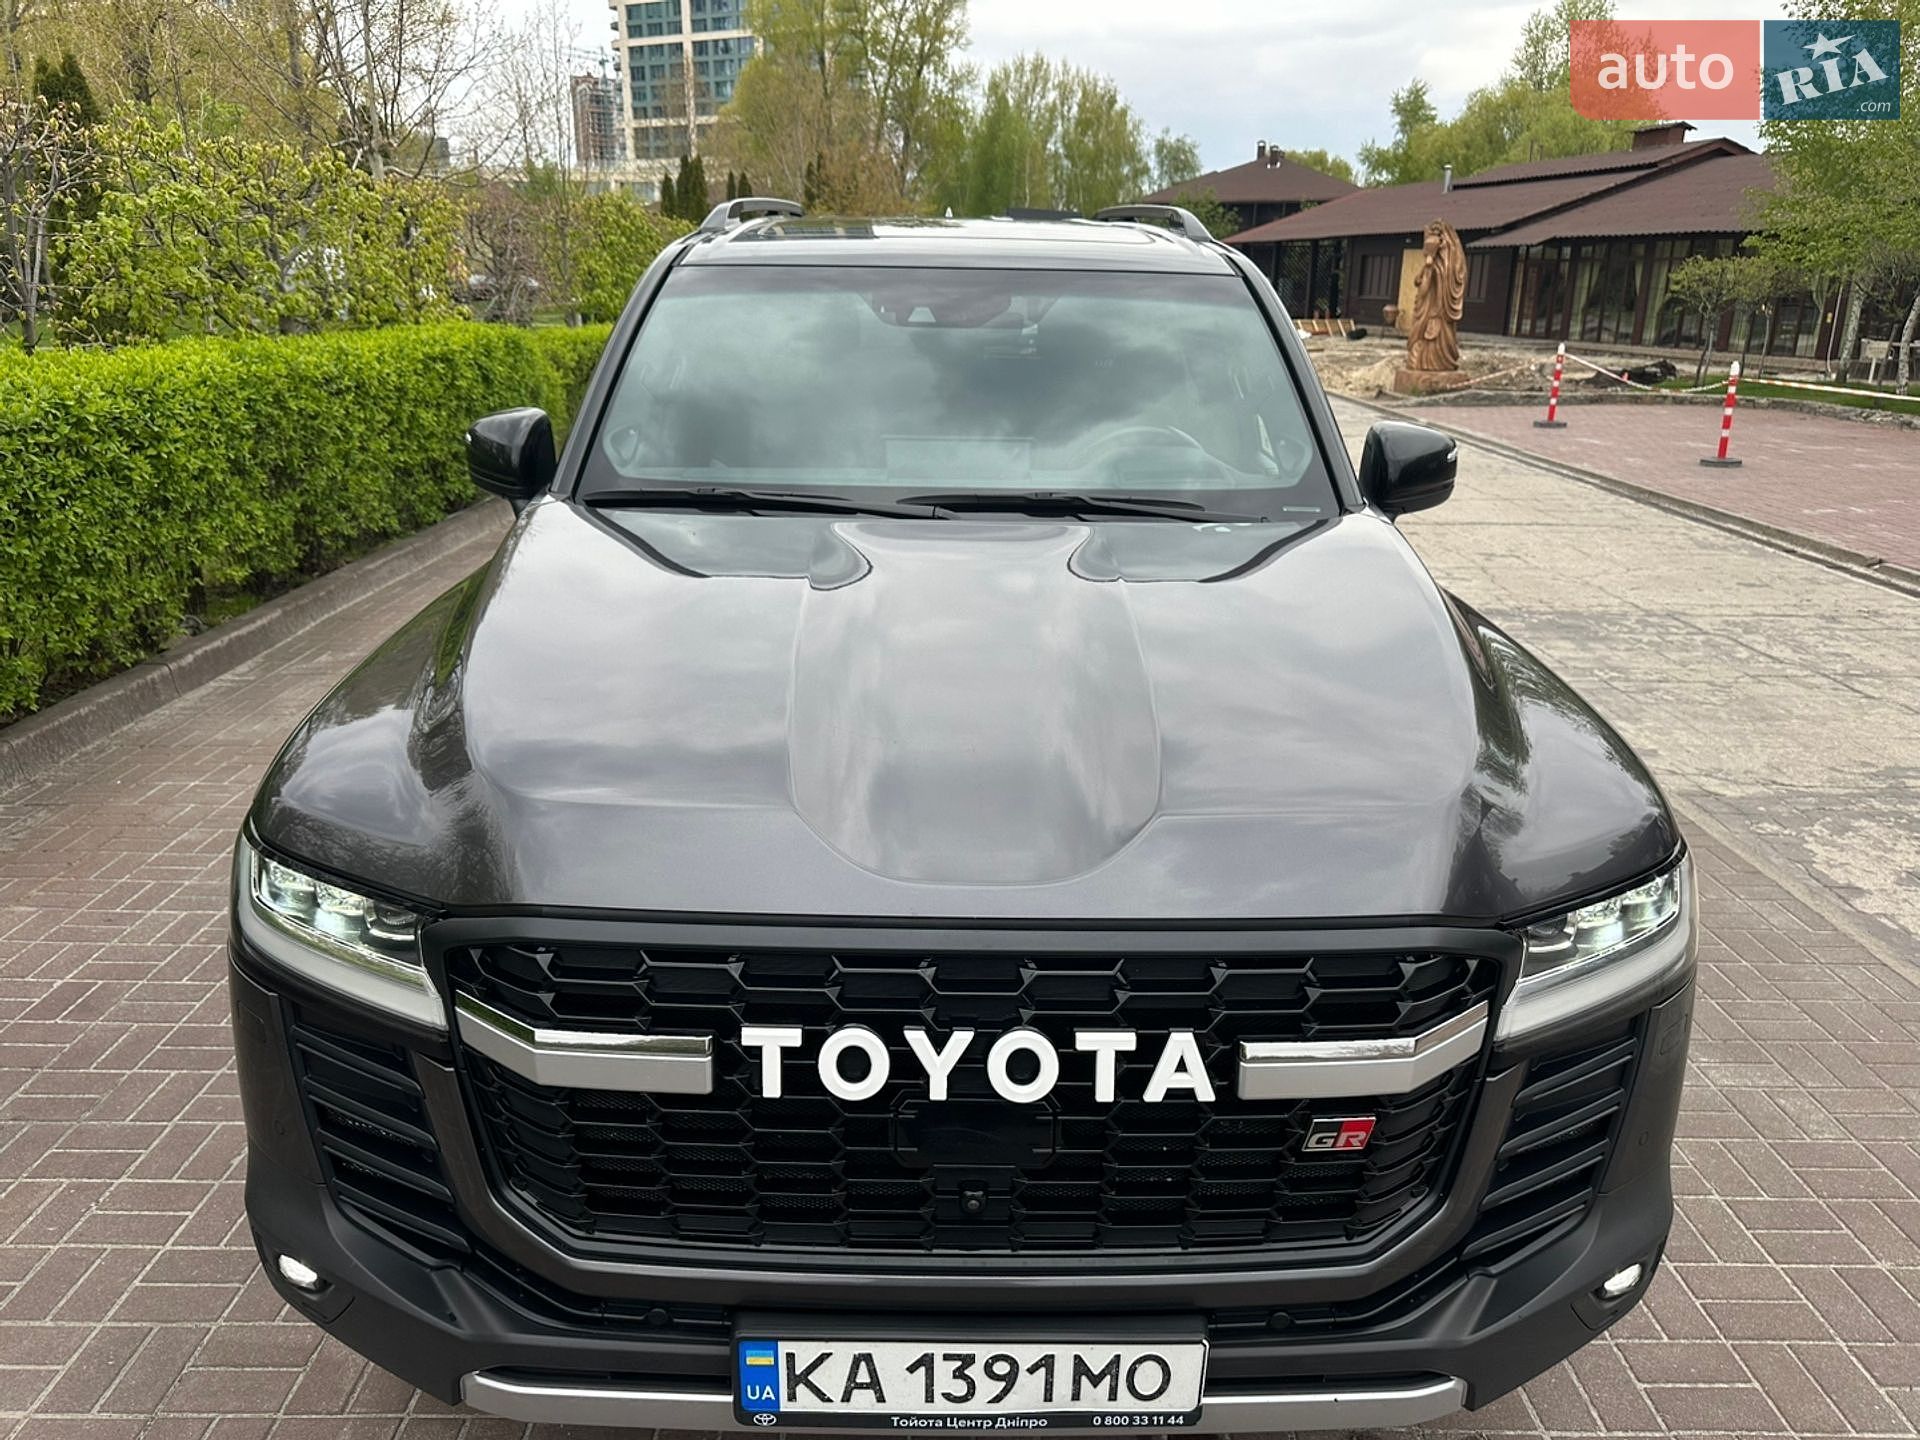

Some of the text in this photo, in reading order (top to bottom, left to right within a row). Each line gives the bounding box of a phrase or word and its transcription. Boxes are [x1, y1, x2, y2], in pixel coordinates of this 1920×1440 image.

[741, 1027, 1216, 1102] TOYOTA
[1307, 1131, 1367, 1148] GR
[785, 1352, 887, 1404] KA
[747, 1385, 776, 1401] UA
[891, 1415, 1048, 1430] Тойота Центр Дніпро
[1104, 1415, 1130, 1426] 800
